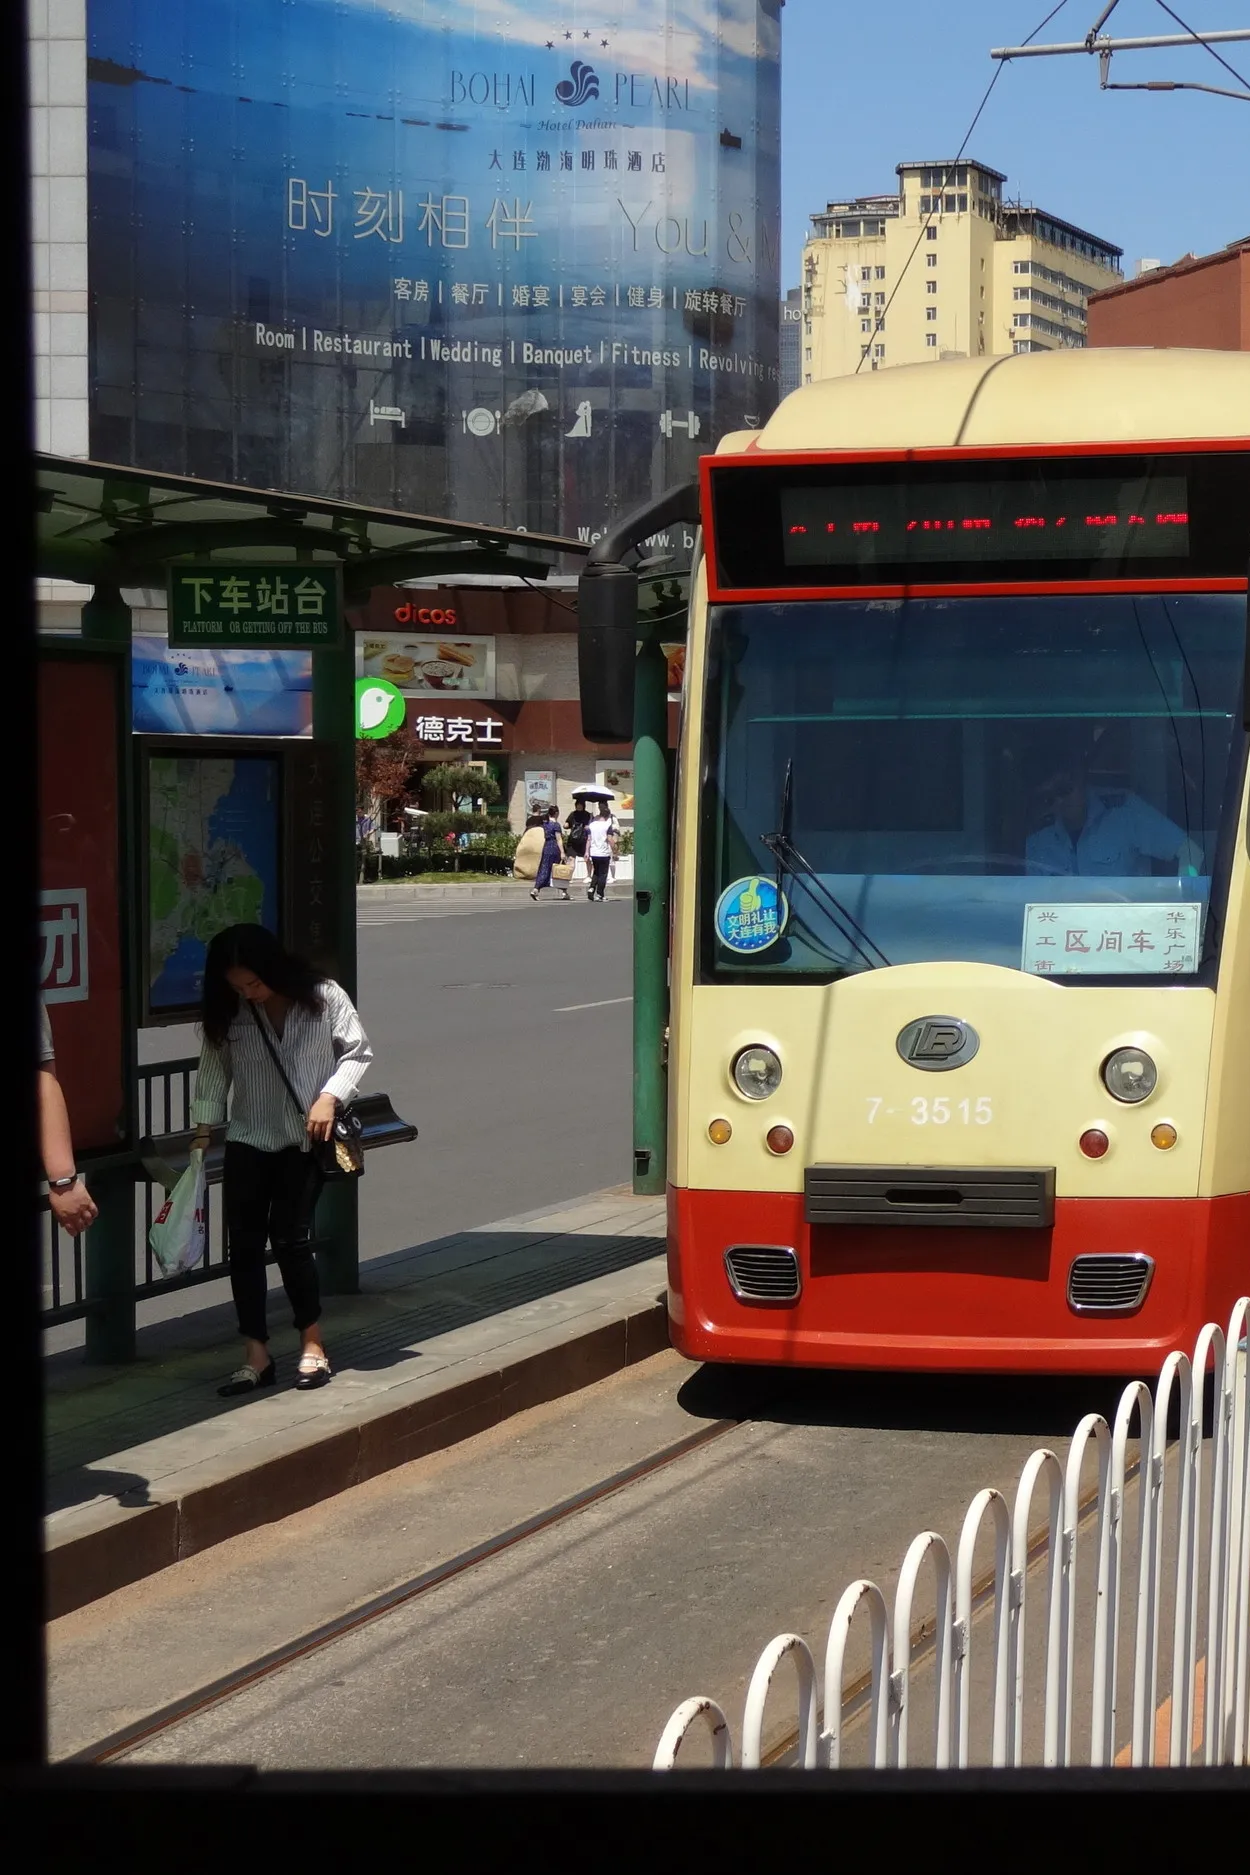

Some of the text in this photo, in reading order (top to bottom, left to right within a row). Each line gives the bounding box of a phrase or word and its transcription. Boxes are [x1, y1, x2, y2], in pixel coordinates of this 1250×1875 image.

[451, 70, 699, 112] BOHAI PEARL
[537, 119, 572, 132] Hotel
[488, 149, 666, 173] 大连渤海明珠酒店
[288, 178, 539, 251] 时刻相伴
[616, 198, 709, 257] You
[394, 277, 747, 318] 客房 餐厅 婚宴 宴会 健身 旋转餐厅
[256, 322, 294, 349] Room
[313, 329, 412, 359] Restaurant
[431, 338, 502, 367] Wedding
[523, 343, 592, 368] Banquet
[612, 343, 680, 366] Fitness
[700, 347, 764, 381] Revolving
[181, 576, 326, 615] 下车站台
[394, 603, 457, 625] dicos
[242, 622, 276, 634] GETTING
[278, 622, 292, 634] OFF
[295, 622, 310, 634] THE
[313, 622, 328, 634] BUS
[416, 716, 503, 743] 德克士
[727, 908, 777, 928] 文明礼让
[728, 921, 777, 941] 大连有我
[1064, 929, 1156, 954] 区间车
